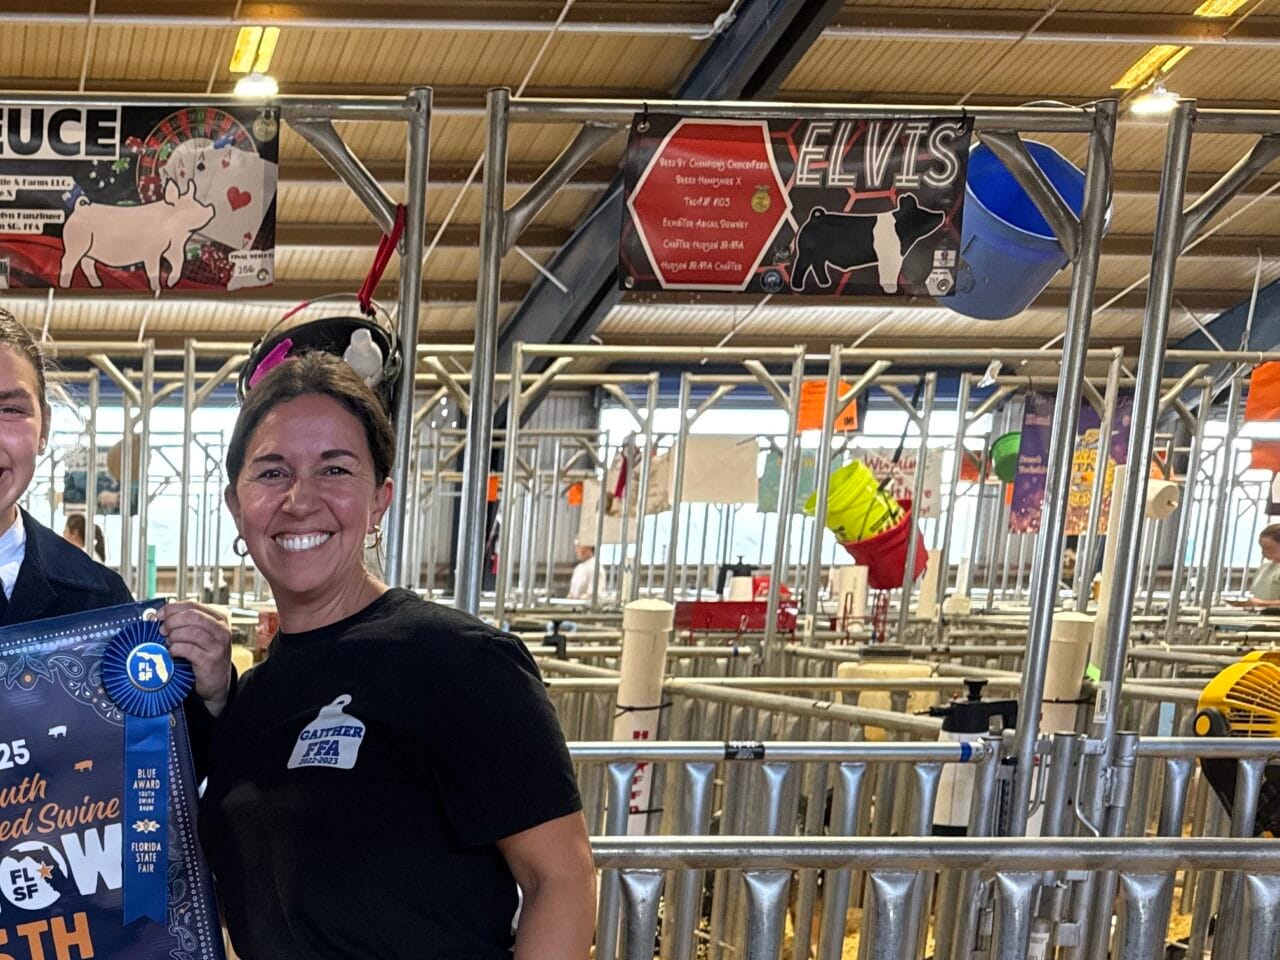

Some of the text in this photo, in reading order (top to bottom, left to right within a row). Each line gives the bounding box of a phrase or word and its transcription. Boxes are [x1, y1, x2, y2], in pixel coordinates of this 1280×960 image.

[796, 122, 959, 187] ELVIS
[139, 662, 152, 671] FL
[300, 725, 363, 740] GAITHER
[302, 740, 340, 757] FFA
[137, 769, 156, 778] BLUE
[133, 780, 160, 789] AWARD
[37, 796, 120, 833] Swine
[131, 842, 161, 851] FLORIDA
[135, 853, 157, 862] STATE
[138, 864, 154, 873] FAIR
[9, 867, 35, 886] FL
[13, 884, 39, 901] SF
